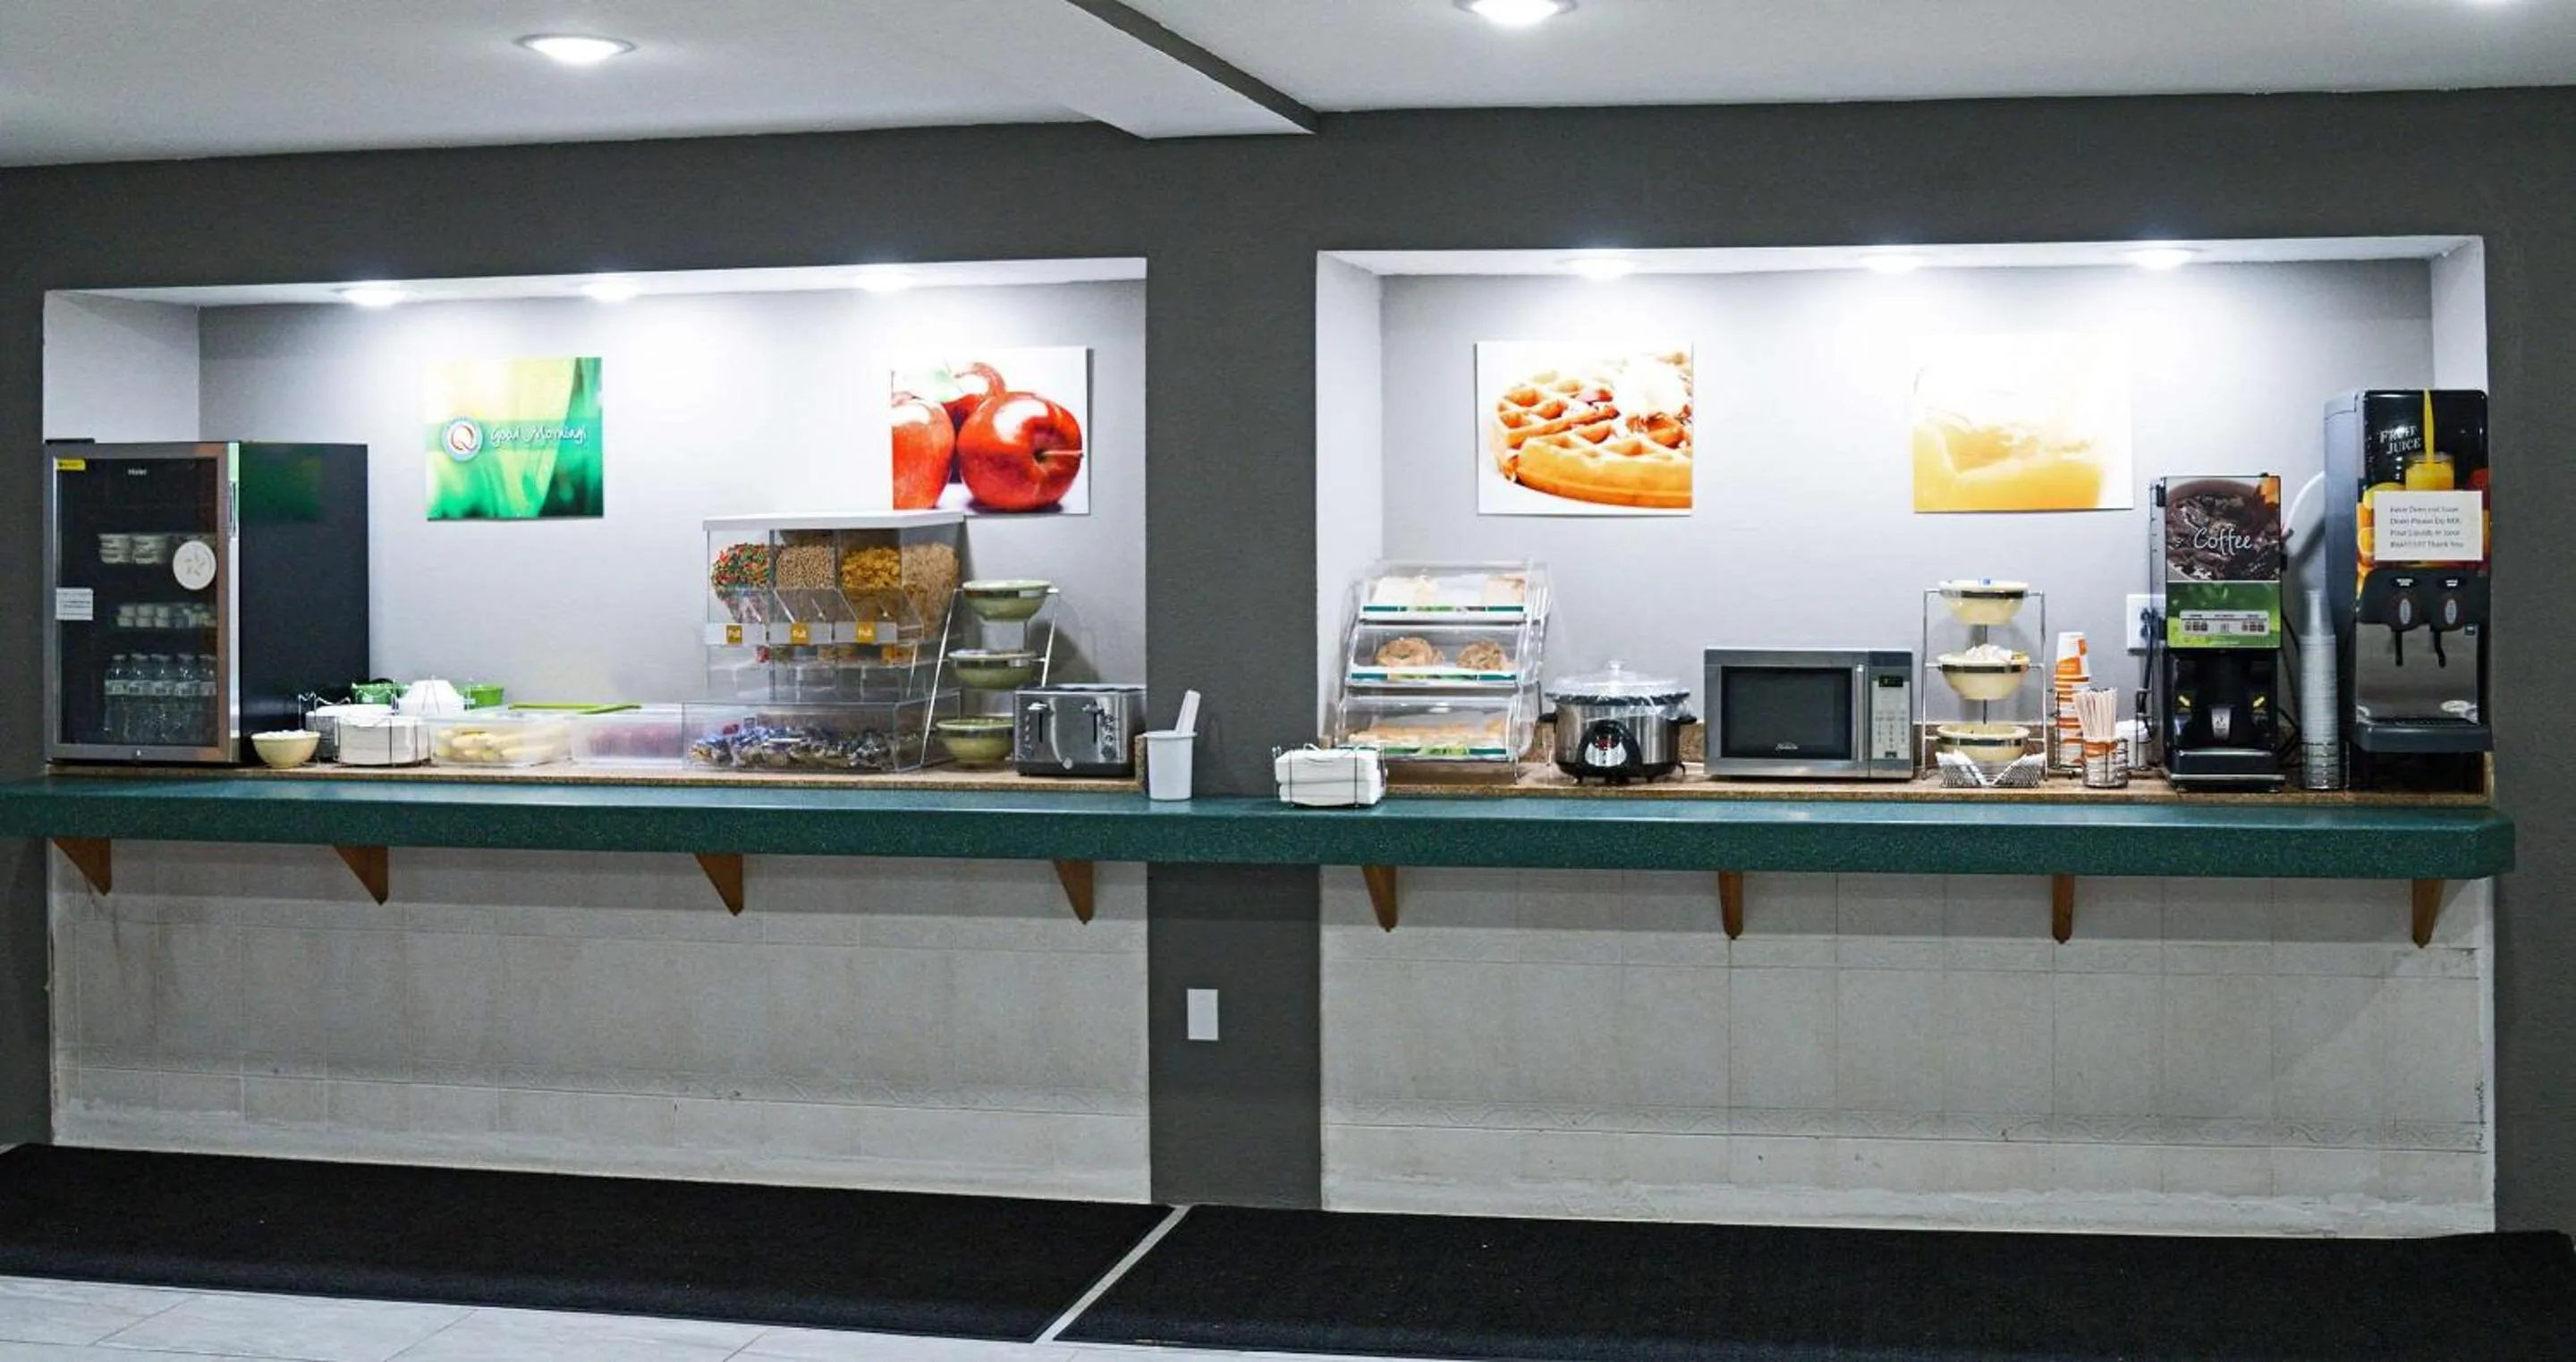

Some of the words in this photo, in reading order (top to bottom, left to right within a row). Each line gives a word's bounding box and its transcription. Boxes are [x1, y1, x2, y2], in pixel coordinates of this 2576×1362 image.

[491, 425, 521, 447] Good
[2379, 425, 2417, 444] FRUIT
[2385, 437, 2420, 454] JUICE
[2194, 526, 2252, 556] Coffee
